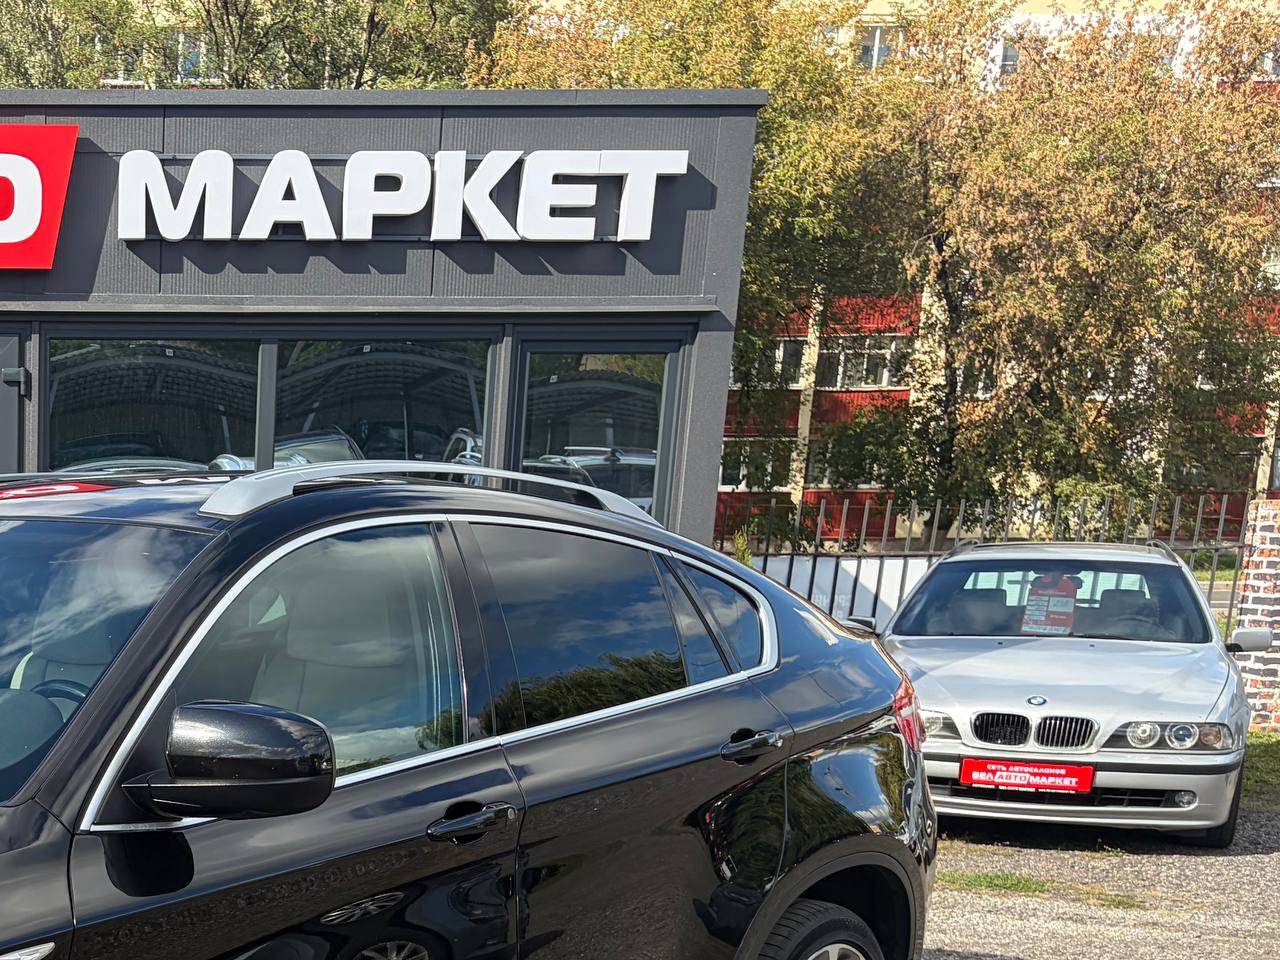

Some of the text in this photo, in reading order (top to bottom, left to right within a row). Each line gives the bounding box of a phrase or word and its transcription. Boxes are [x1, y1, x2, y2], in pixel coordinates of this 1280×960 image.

[117, 148, 690, 243] МАРКЕТ
[986, 763, 1066, 775] СЕТЬ АВТОСАЛОНОВ
[971, 771, 1079, 786] БЕЛ АВТО МАРКЕТ
